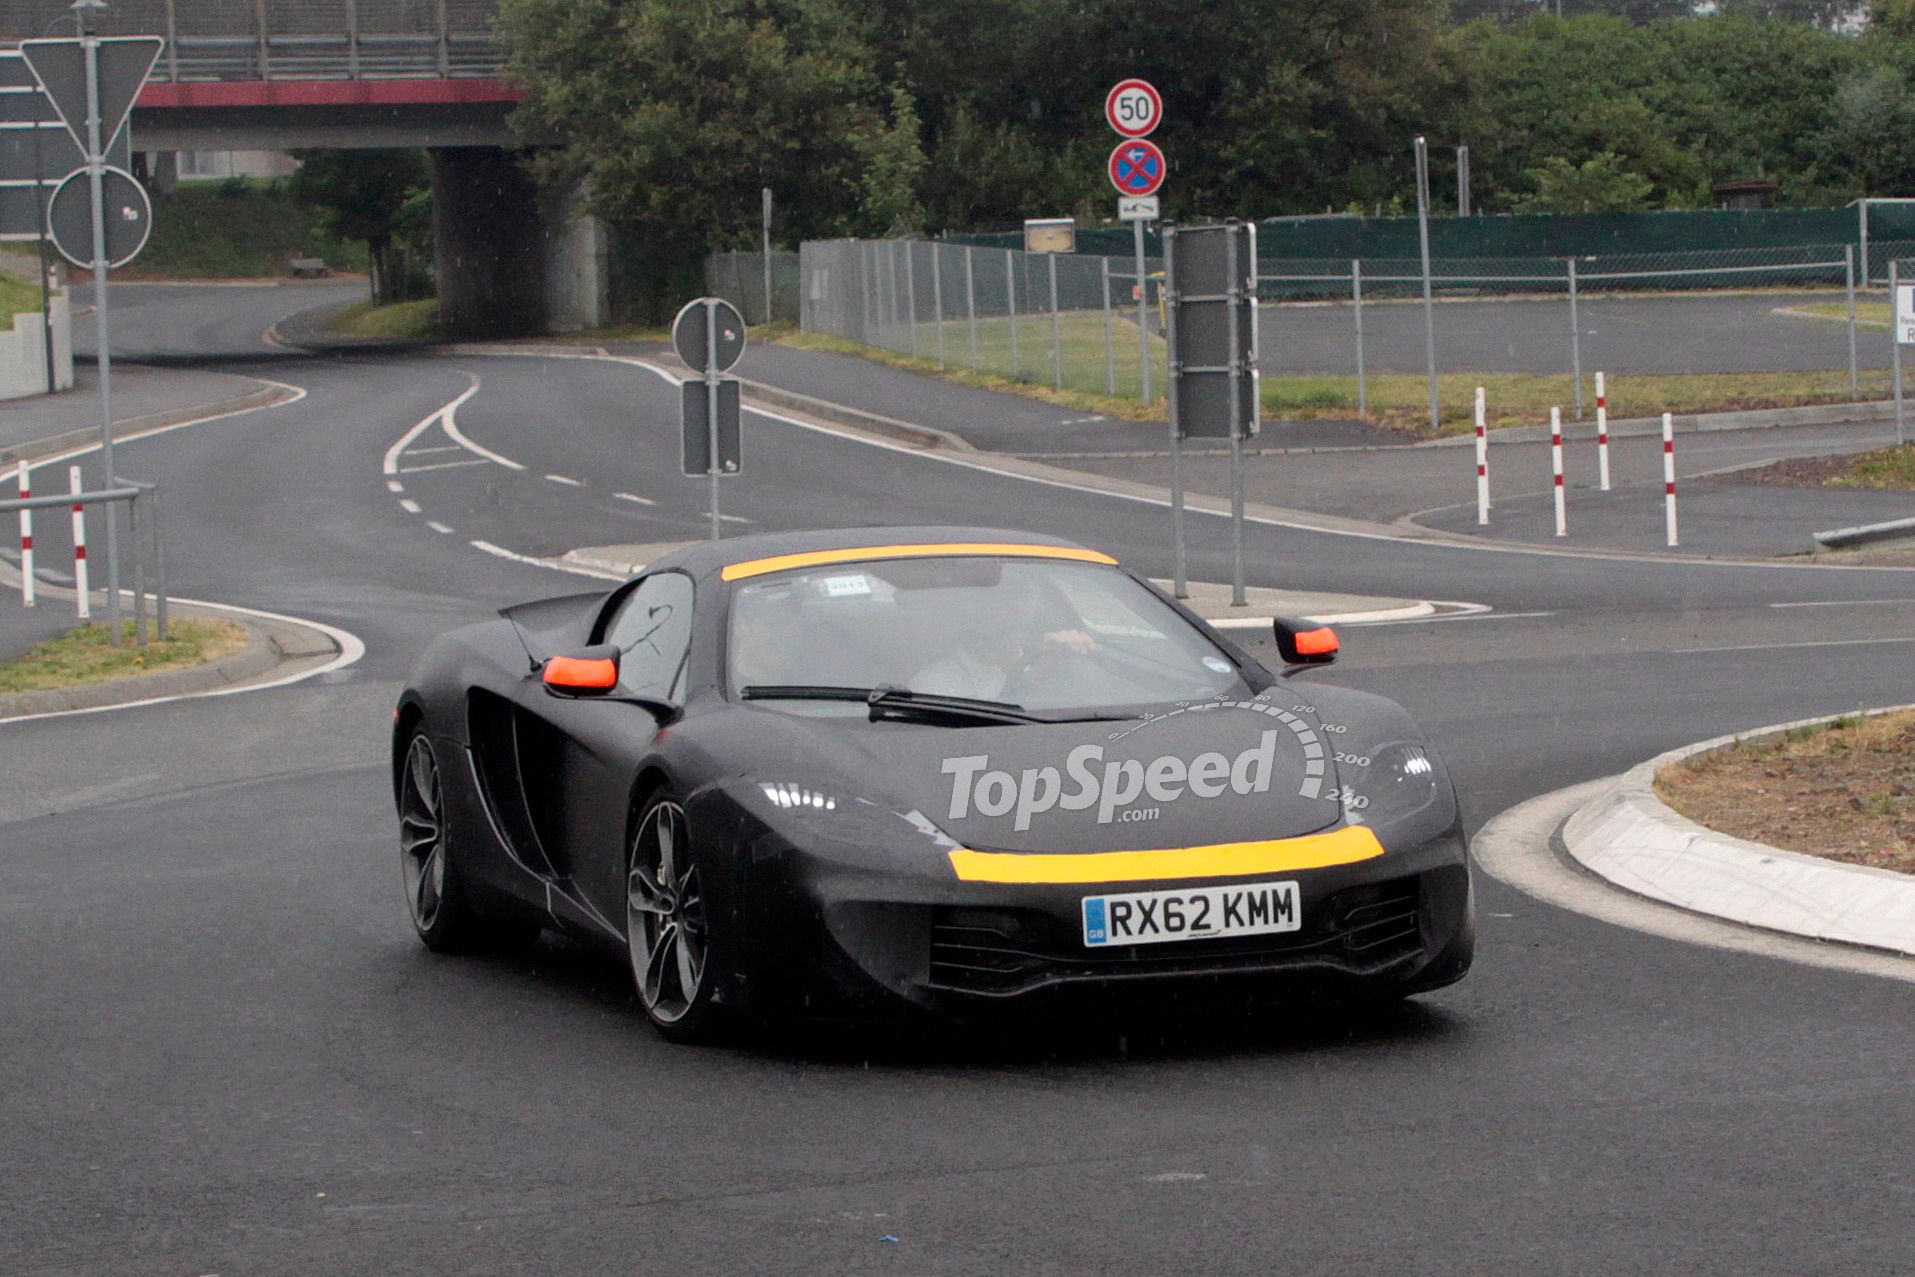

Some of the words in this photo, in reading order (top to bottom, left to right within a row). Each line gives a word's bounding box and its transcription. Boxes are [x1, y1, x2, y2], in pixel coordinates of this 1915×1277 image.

[1120, 96, 1149, 121] 50
[1109, 895, 1212, 937] RX62
[1222, 887, 1294, 928] KMM
[1088, 929, 1105, 940] GB
